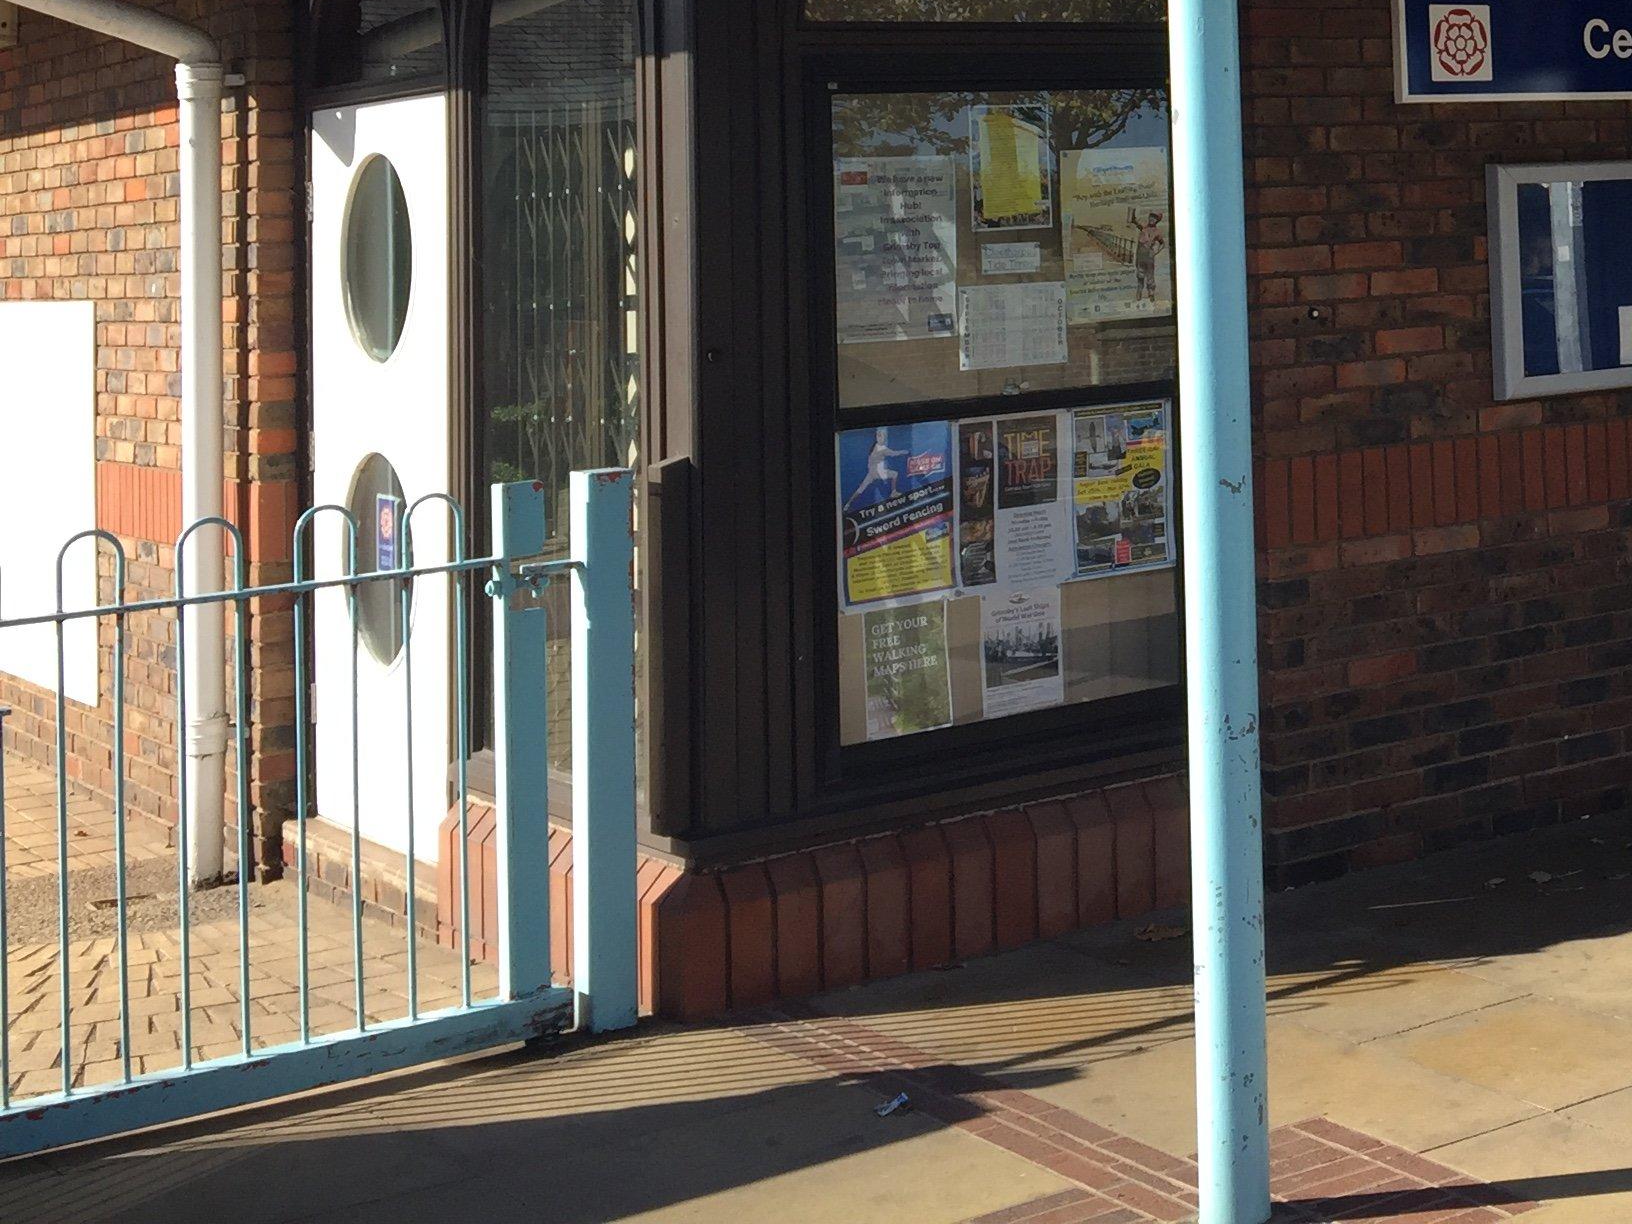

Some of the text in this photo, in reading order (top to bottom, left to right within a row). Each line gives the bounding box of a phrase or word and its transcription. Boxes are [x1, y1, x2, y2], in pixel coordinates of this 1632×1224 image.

[1004, 429, 1051, 461] TIME
[1005, 458, 1053, 485] TRAP
[859, 507, 876, 520] Try
[886, 497, 906, 508] new
[866, 503, 943, 537] Sword Fencing
[871, 616, 928, 636] GET YOUR
[872, 637, 901, 650] FREE
[872, 643, 927, 663] WALKING
[873, 655, 938, 678] MAPS HERE
